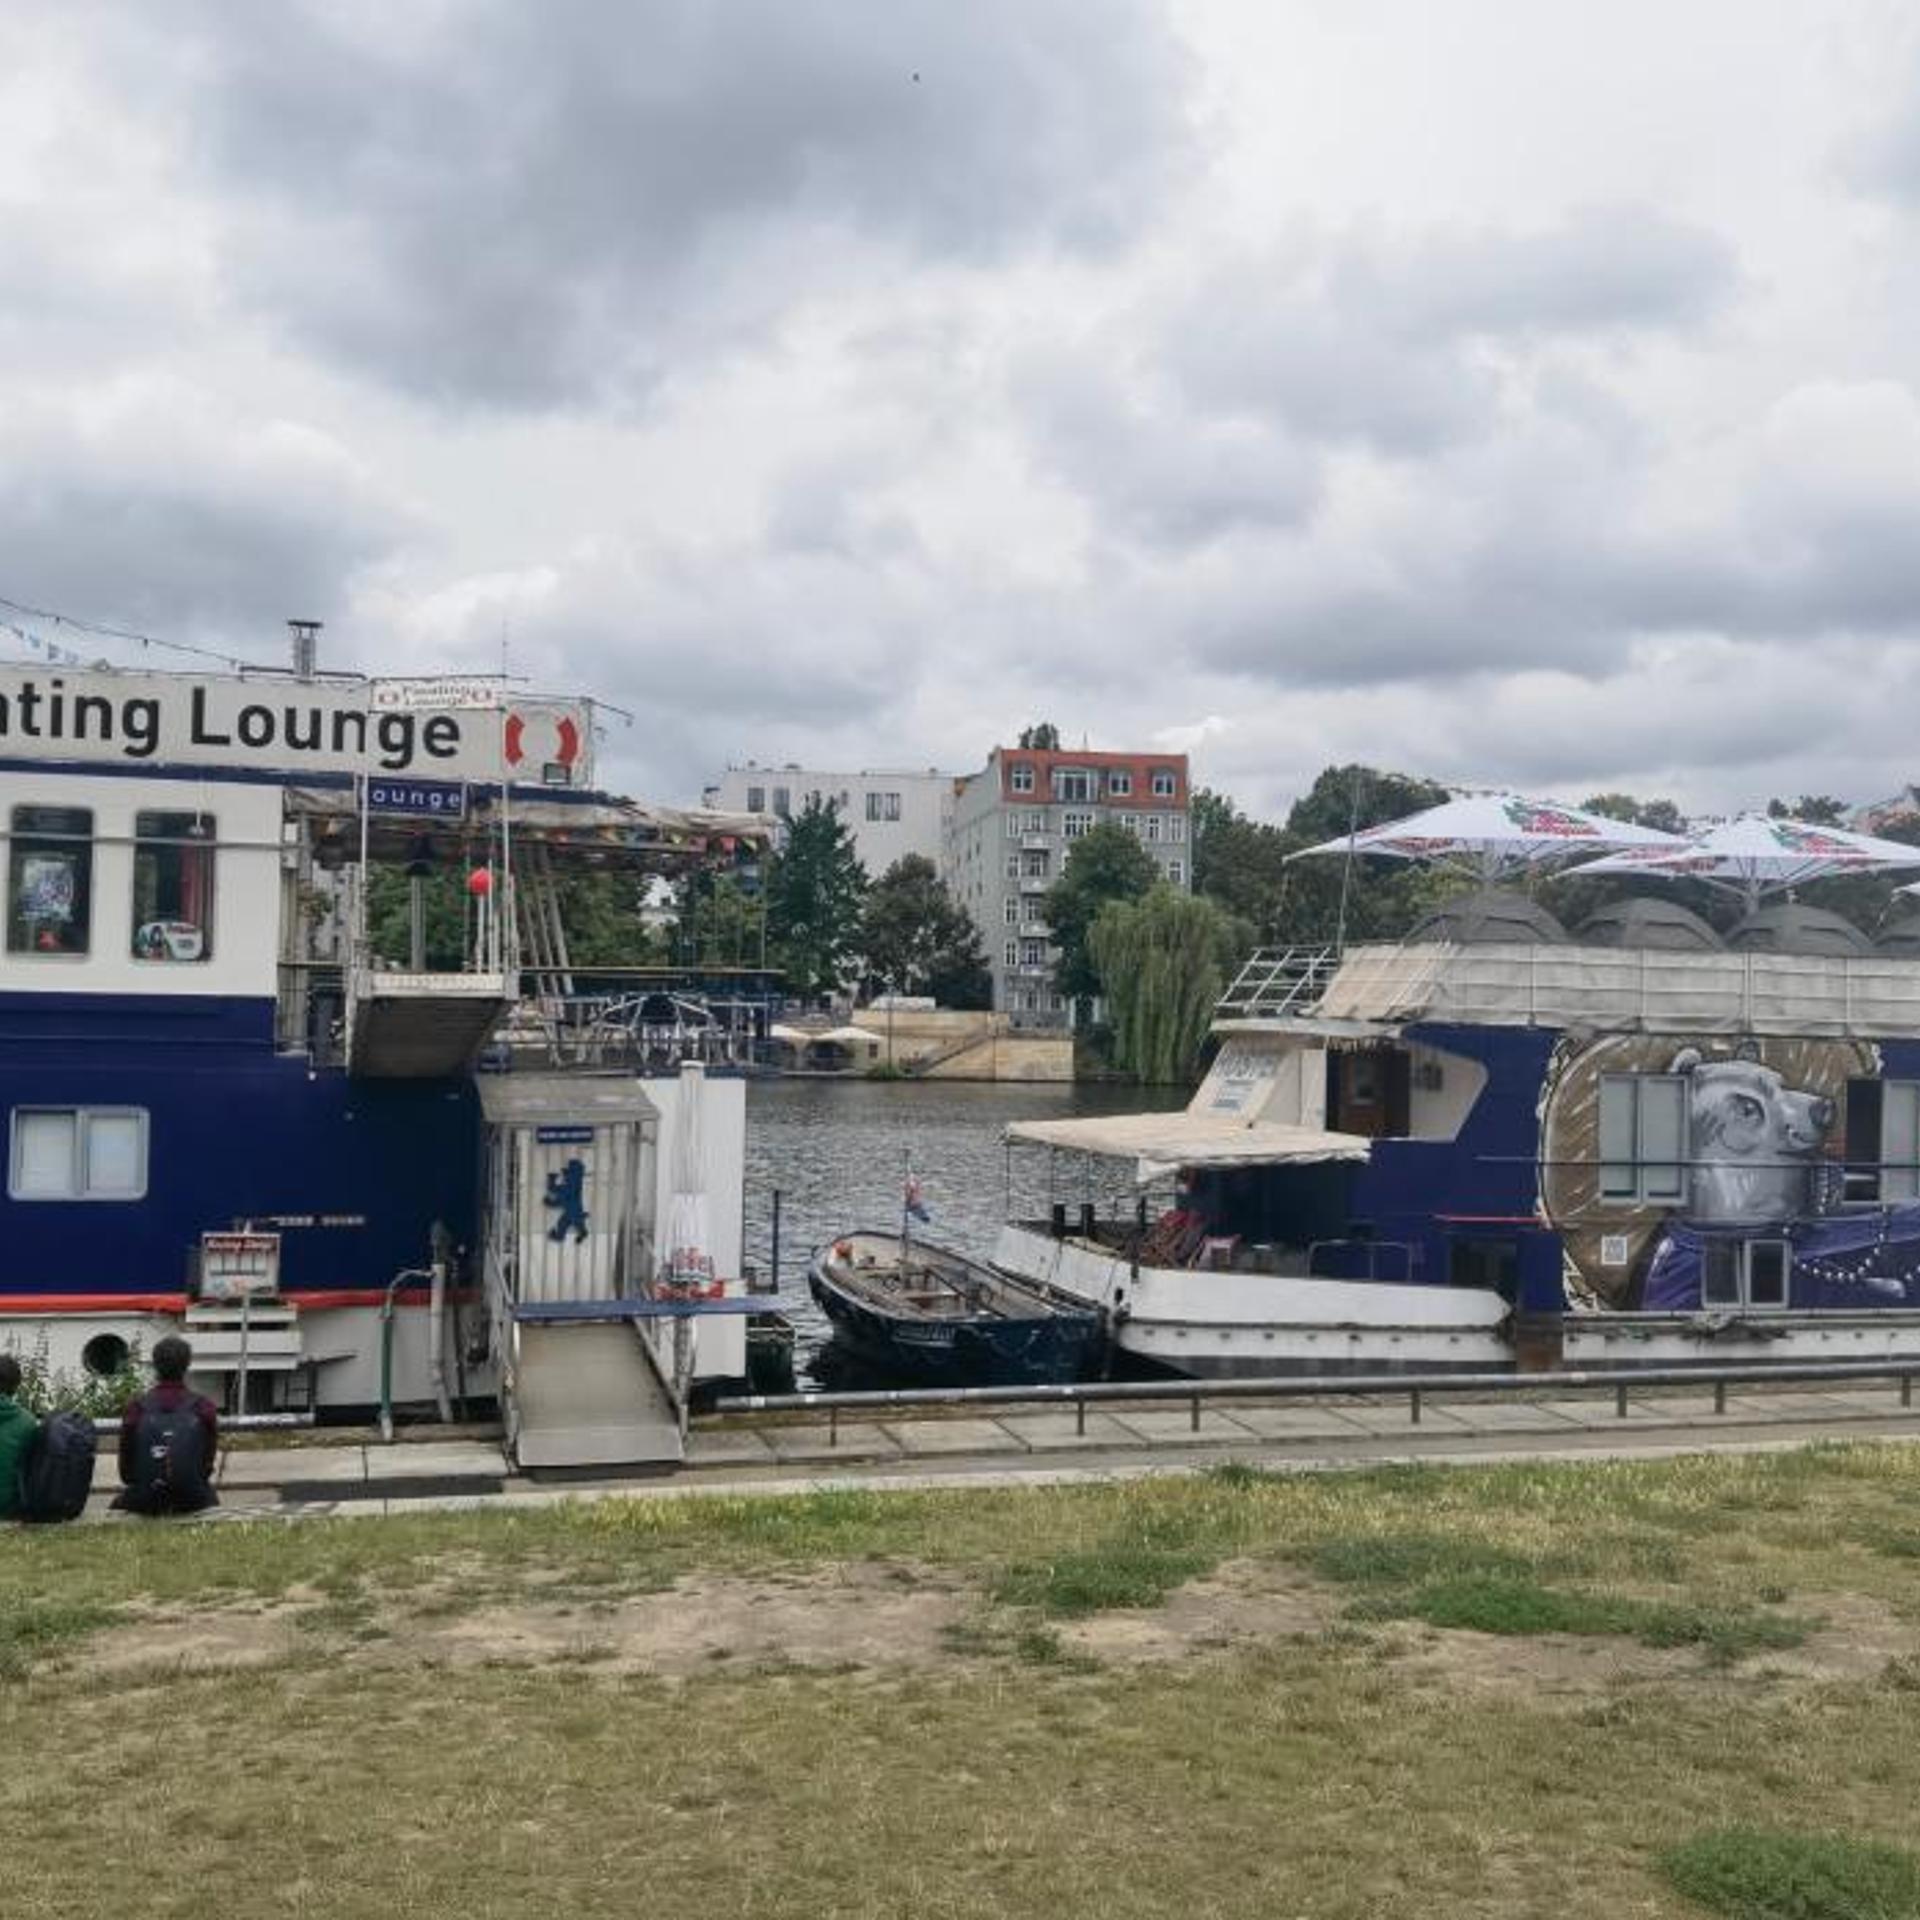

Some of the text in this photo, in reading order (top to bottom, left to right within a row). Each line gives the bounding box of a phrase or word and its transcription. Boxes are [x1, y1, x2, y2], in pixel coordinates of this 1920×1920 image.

[0, 679, 461, 770] ting Lounge
[366, 788, 461, 809] ounge
